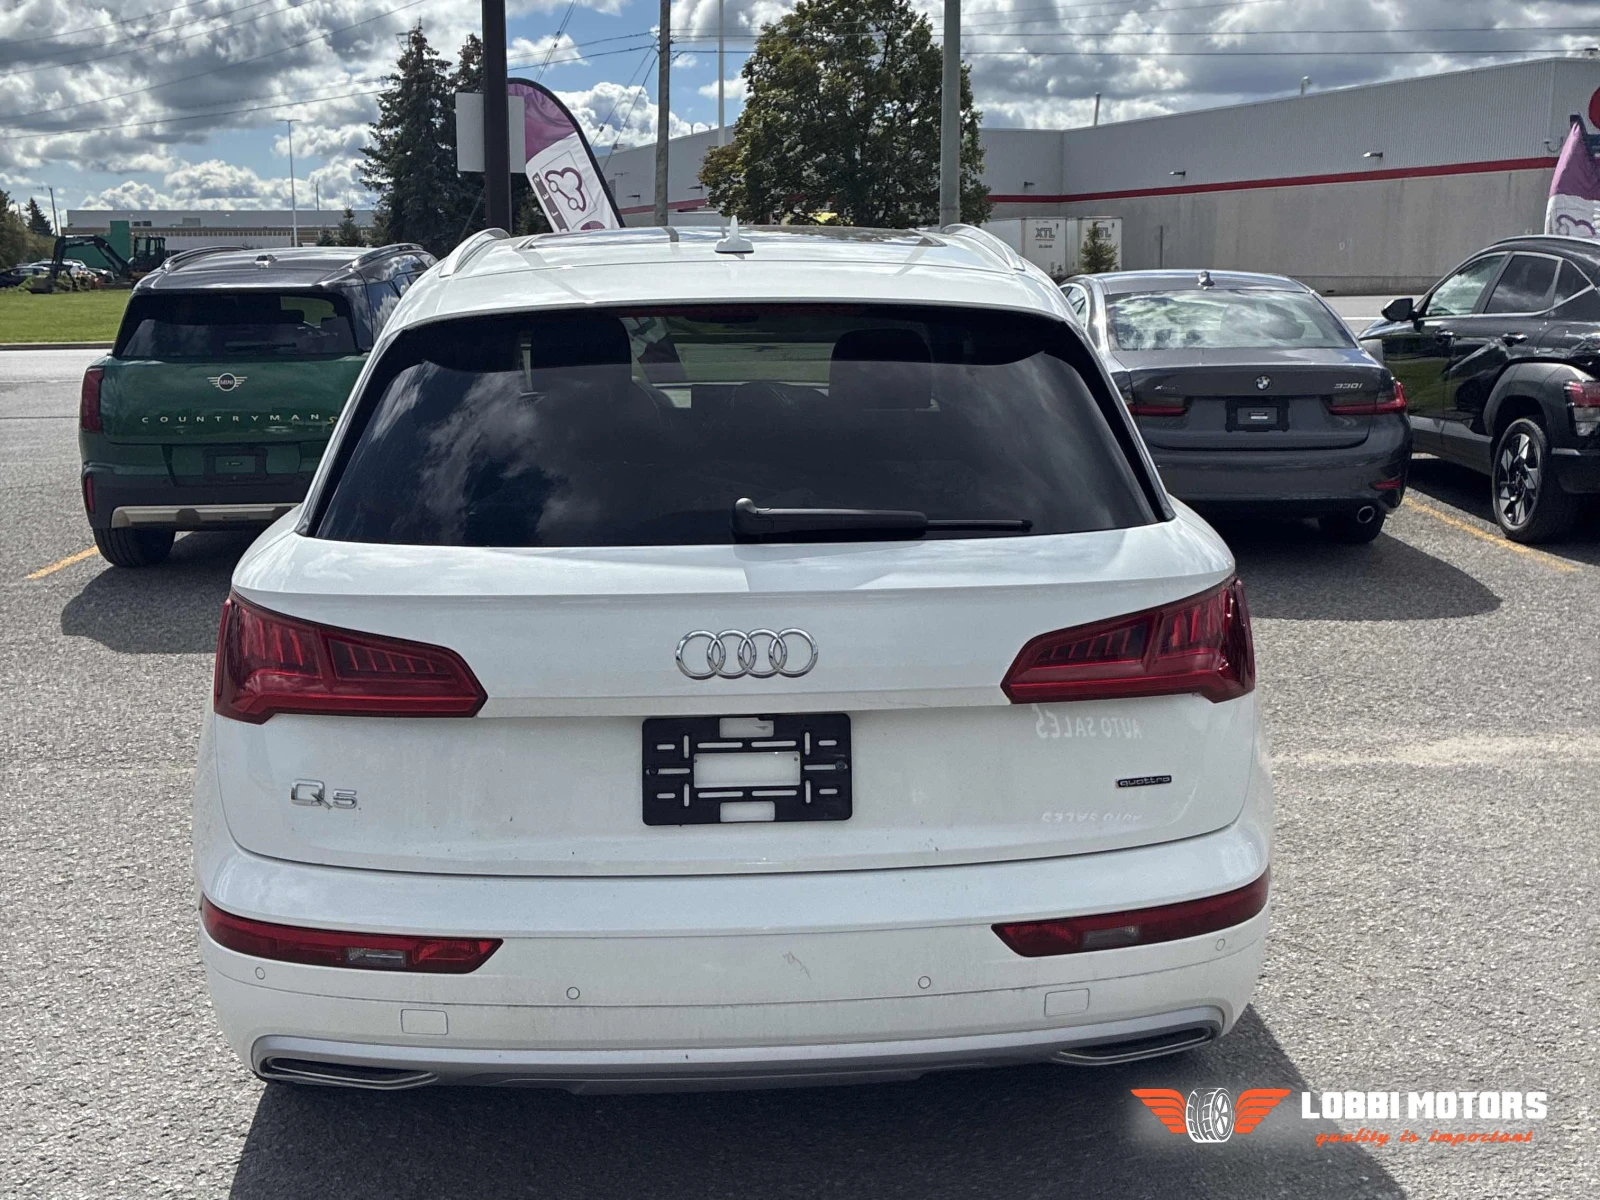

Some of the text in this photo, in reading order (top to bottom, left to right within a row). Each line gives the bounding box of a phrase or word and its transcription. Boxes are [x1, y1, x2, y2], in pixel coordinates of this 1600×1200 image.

[1035, 227, 1056, 239] XTL
[141, 413, 320, 424] COUNTRYMAN
[1119, 776, 1171, 787] quattro
[290, 778, 358, 810] Q5
